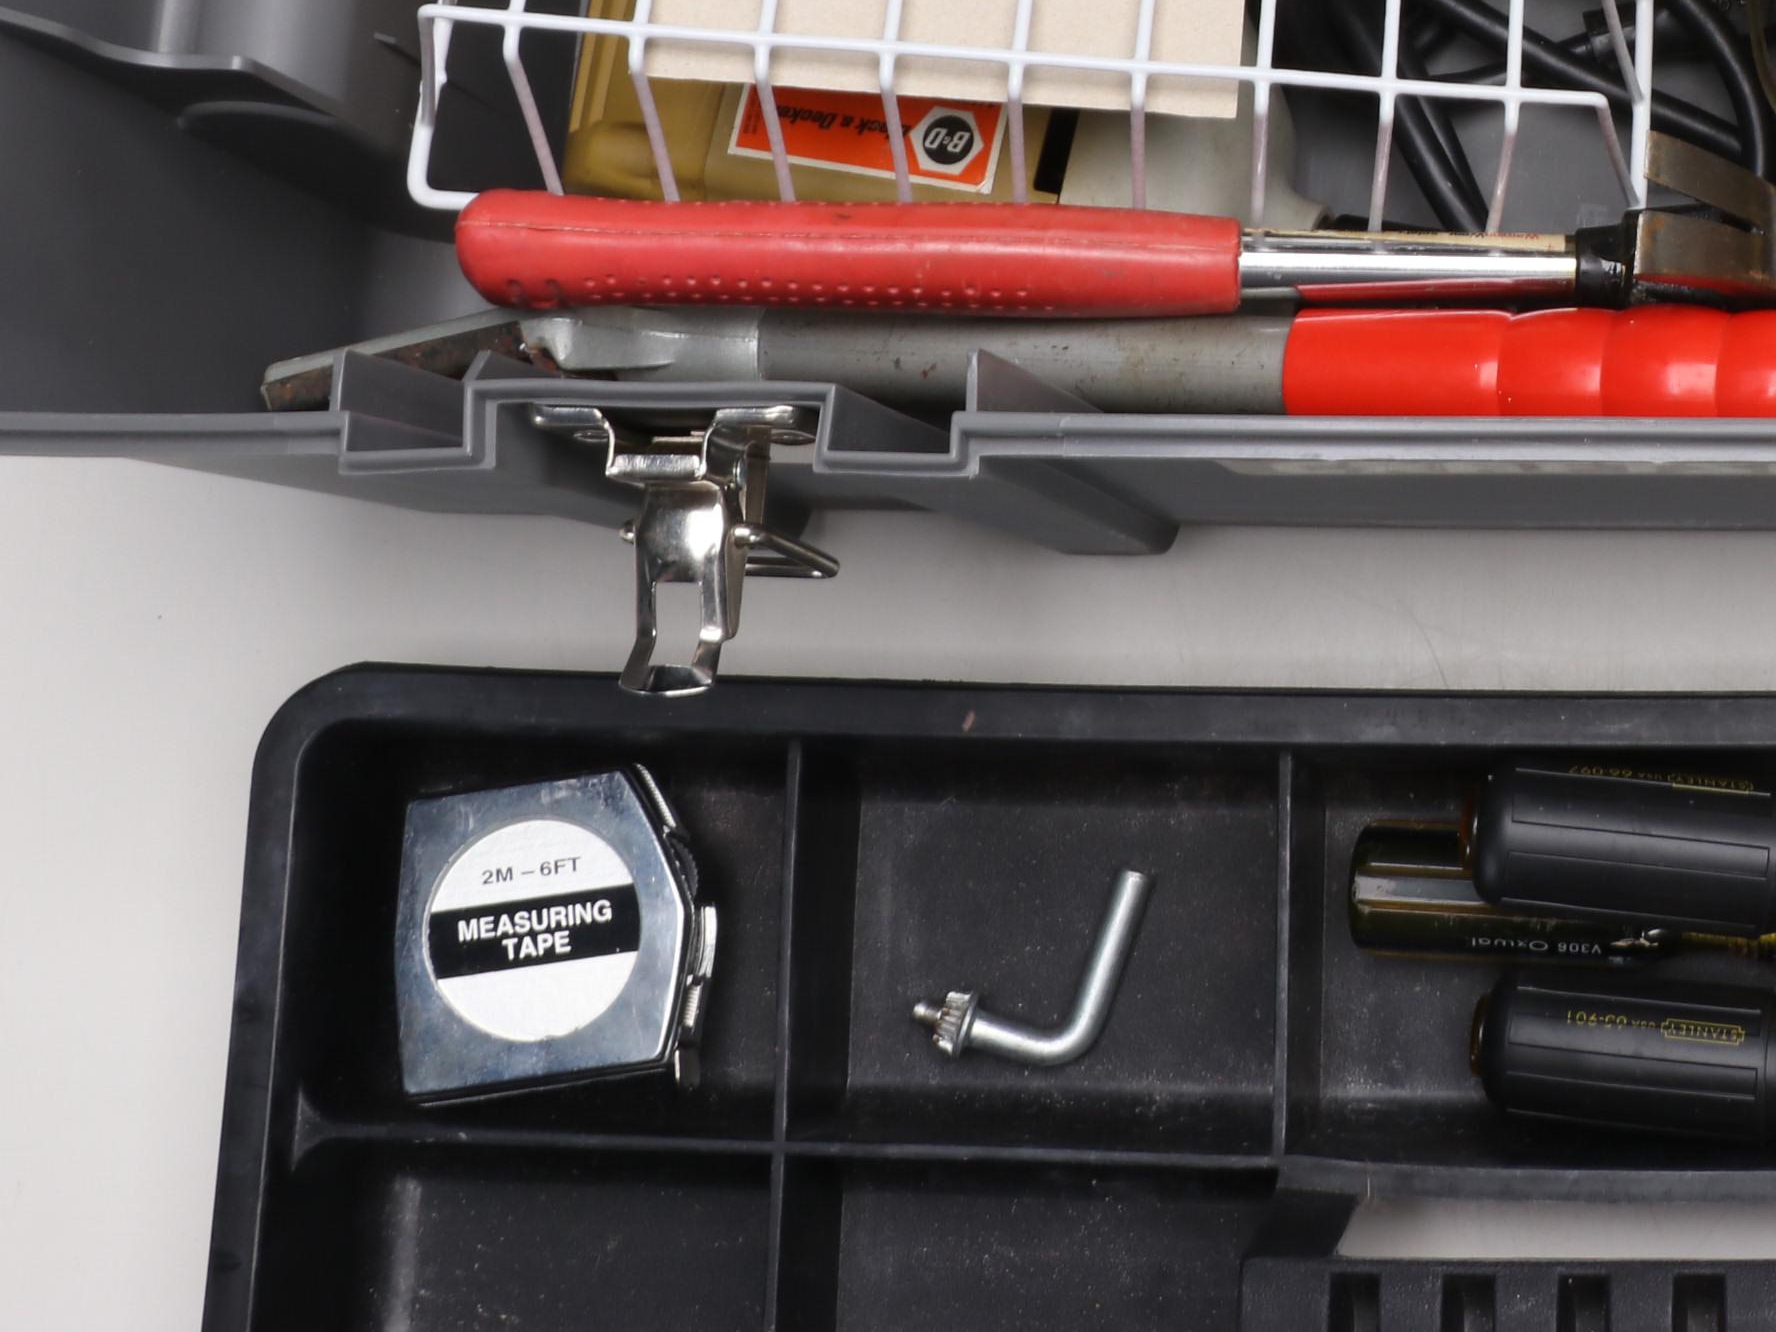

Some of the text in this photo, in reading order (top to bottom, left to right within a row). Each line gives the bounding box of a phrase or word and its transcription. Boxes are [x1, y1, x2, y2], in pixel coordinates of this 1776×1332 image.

[481, 865, 515, 885] 2M
[458, 899, 613, 943] MEASURING
[502, 930, 572, 961] TAPE
[1557, 940, 1602, 955] V306
[1668, 1021, 1740, 1042] STANLEY
